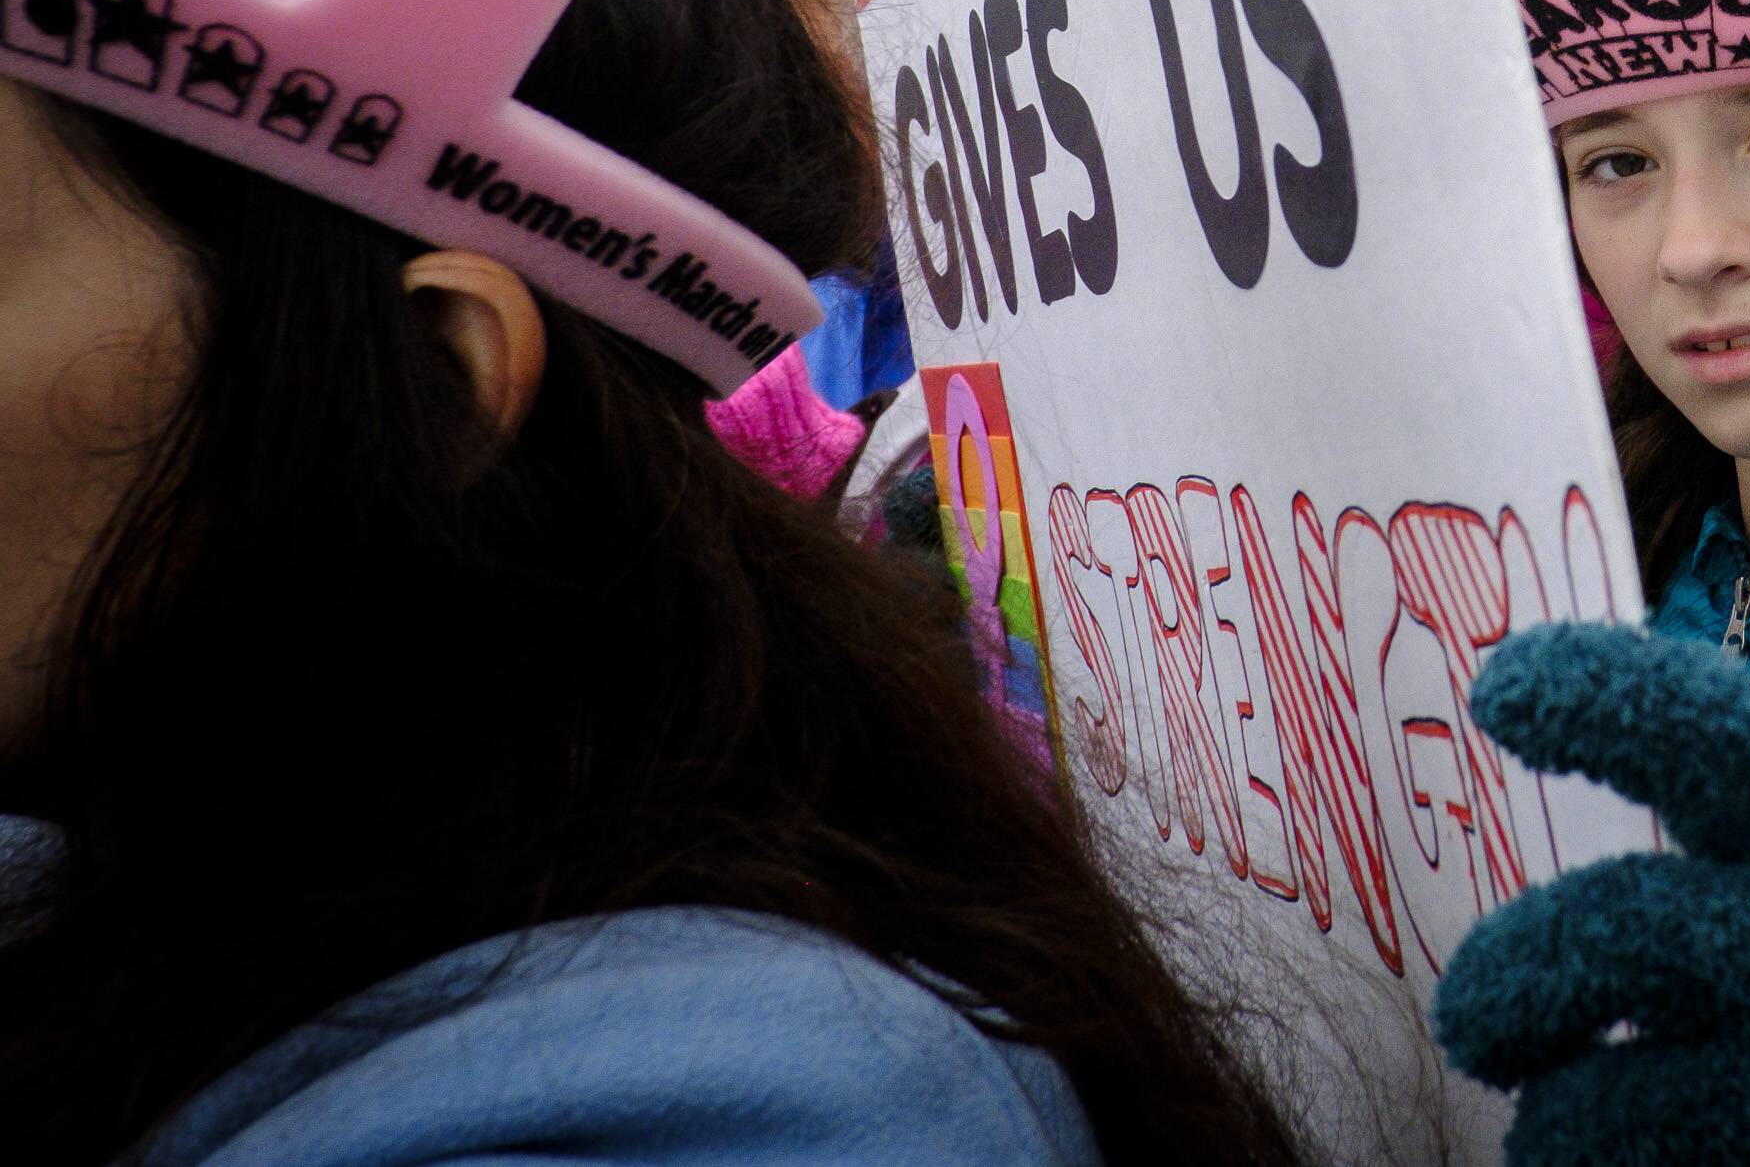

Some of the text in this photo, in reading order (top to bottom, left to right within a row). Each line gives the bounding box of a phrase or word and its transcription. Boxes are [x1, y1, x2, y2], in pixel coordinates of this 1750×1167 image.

[1552, 31, 1714, 92] NEW
[427, 142, 659, 280] Women's
[647, 252, 762, 342] March
